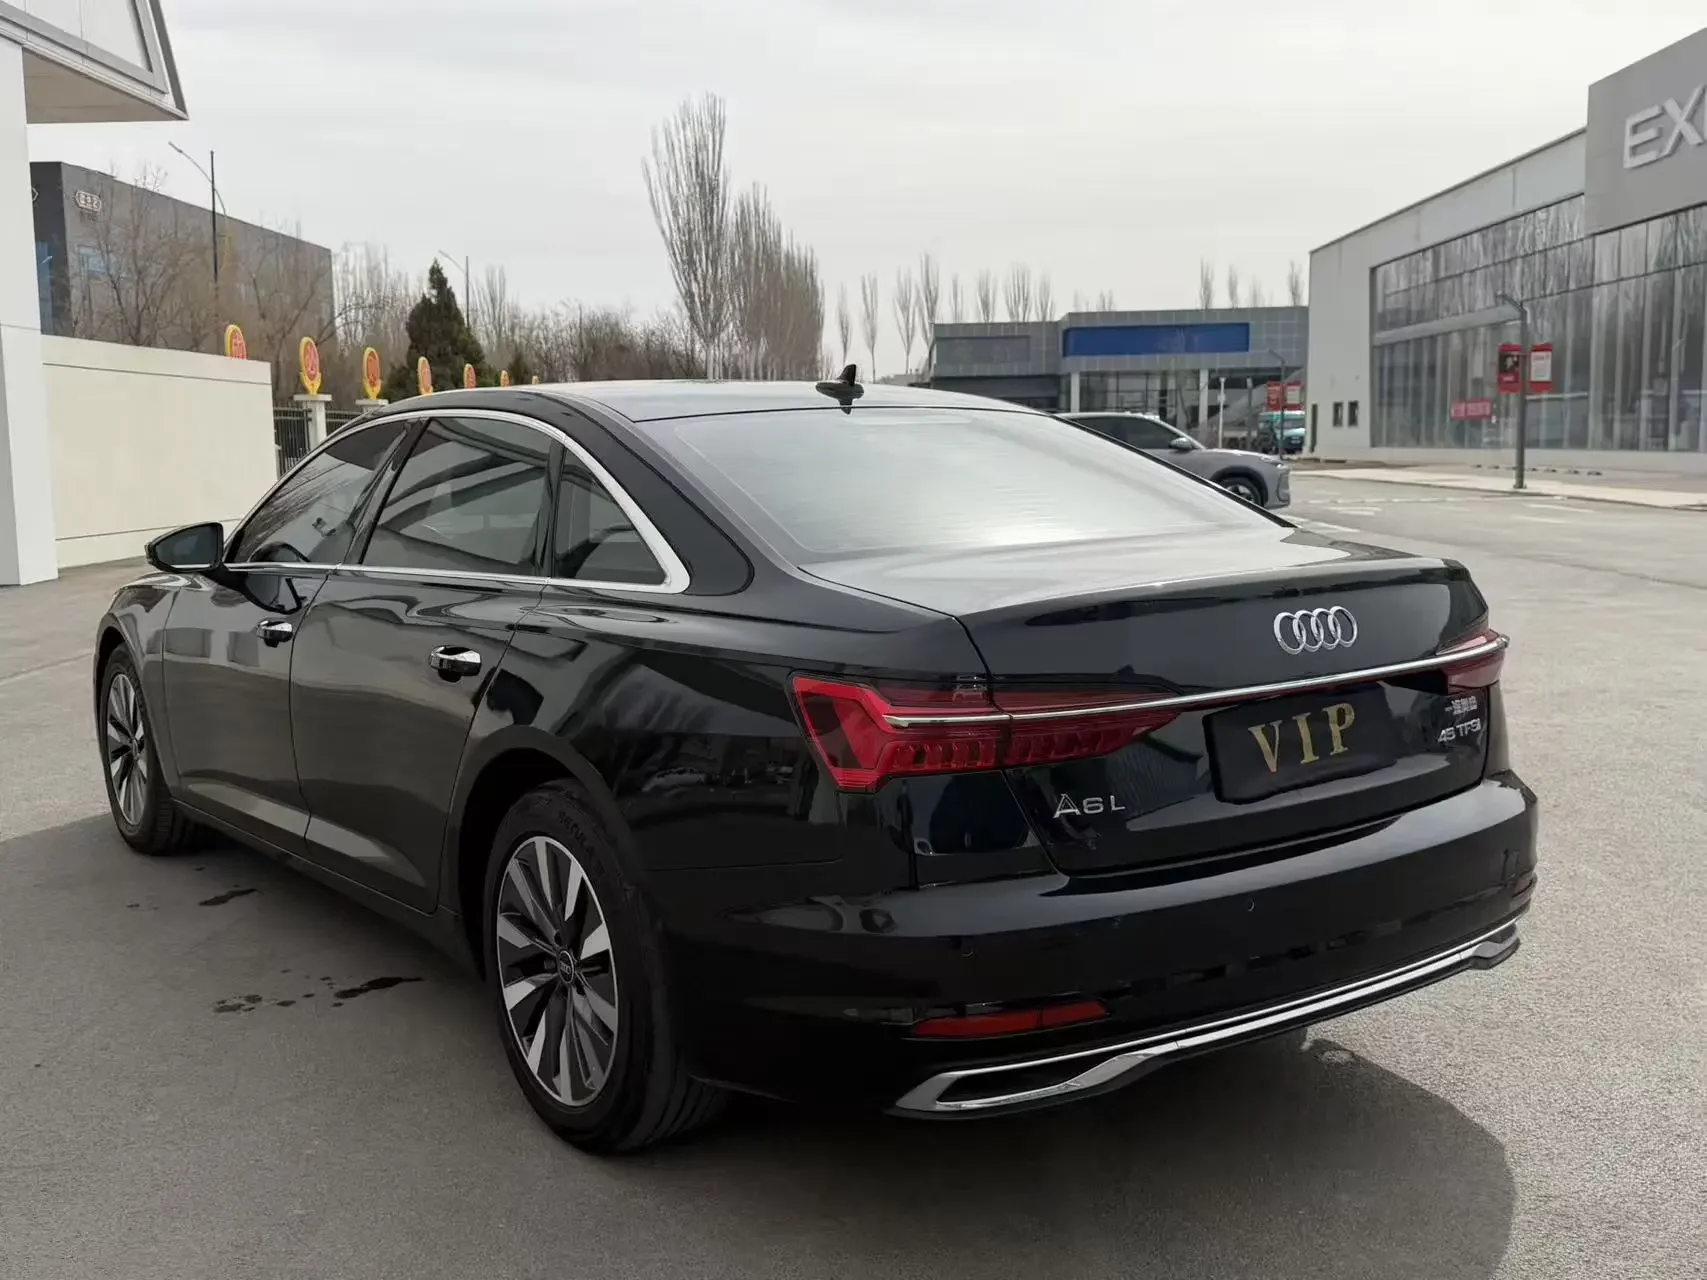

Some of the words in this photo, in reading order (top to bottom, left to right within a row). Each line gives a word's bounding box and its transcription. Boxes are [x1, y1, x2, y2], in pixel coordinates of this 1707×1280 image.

[1623, 80, 1707, 169] EX
[1247, 702, 1356, 774] VIP
[1437, 727, 1456, 744] 45
[1456, 718, 1482, 737] TFSI
